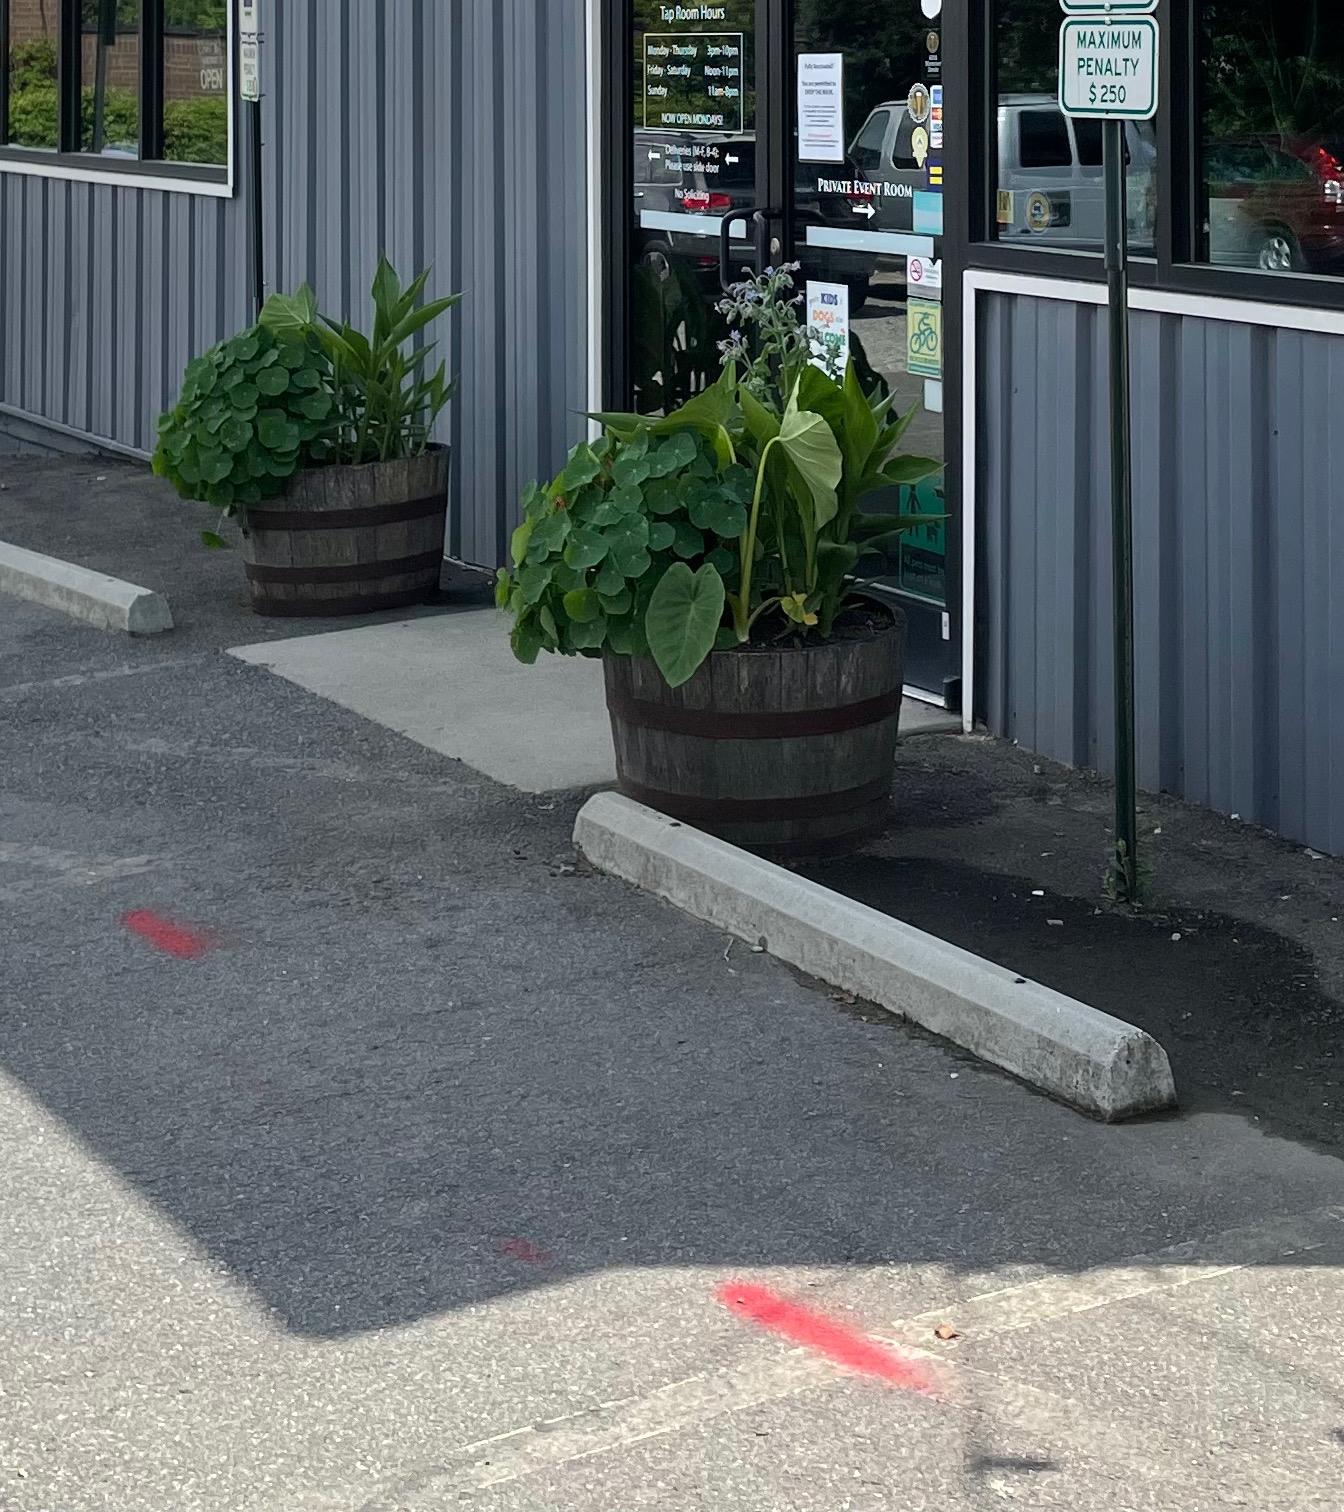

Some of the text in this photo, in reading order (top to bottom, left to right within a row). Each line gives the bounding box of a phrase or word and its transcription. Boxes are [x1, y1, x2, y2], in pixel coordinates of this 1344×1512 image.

[659, 4, 725, 24] Tap Room Hours
[1077, 31, 1142, 49] MAXIMUM
[1077, 58, 1140, 76] PENALTY
[200, 68, 223, 90] OPEN
[647, 85, 668, 98] Sunday
[661, 112, 724, 126] NOW OPEN MONDAYS!
[665, 159, 682, 171] Please
[682, 162, 693, 172] use
[705, 162, 720, 173] door
[674, 188, 710, 204] No Soliciting
[817, 177, 913, 198] PRIVATE EVENT ROOM
[820, 292, 838, 306] KIDS
